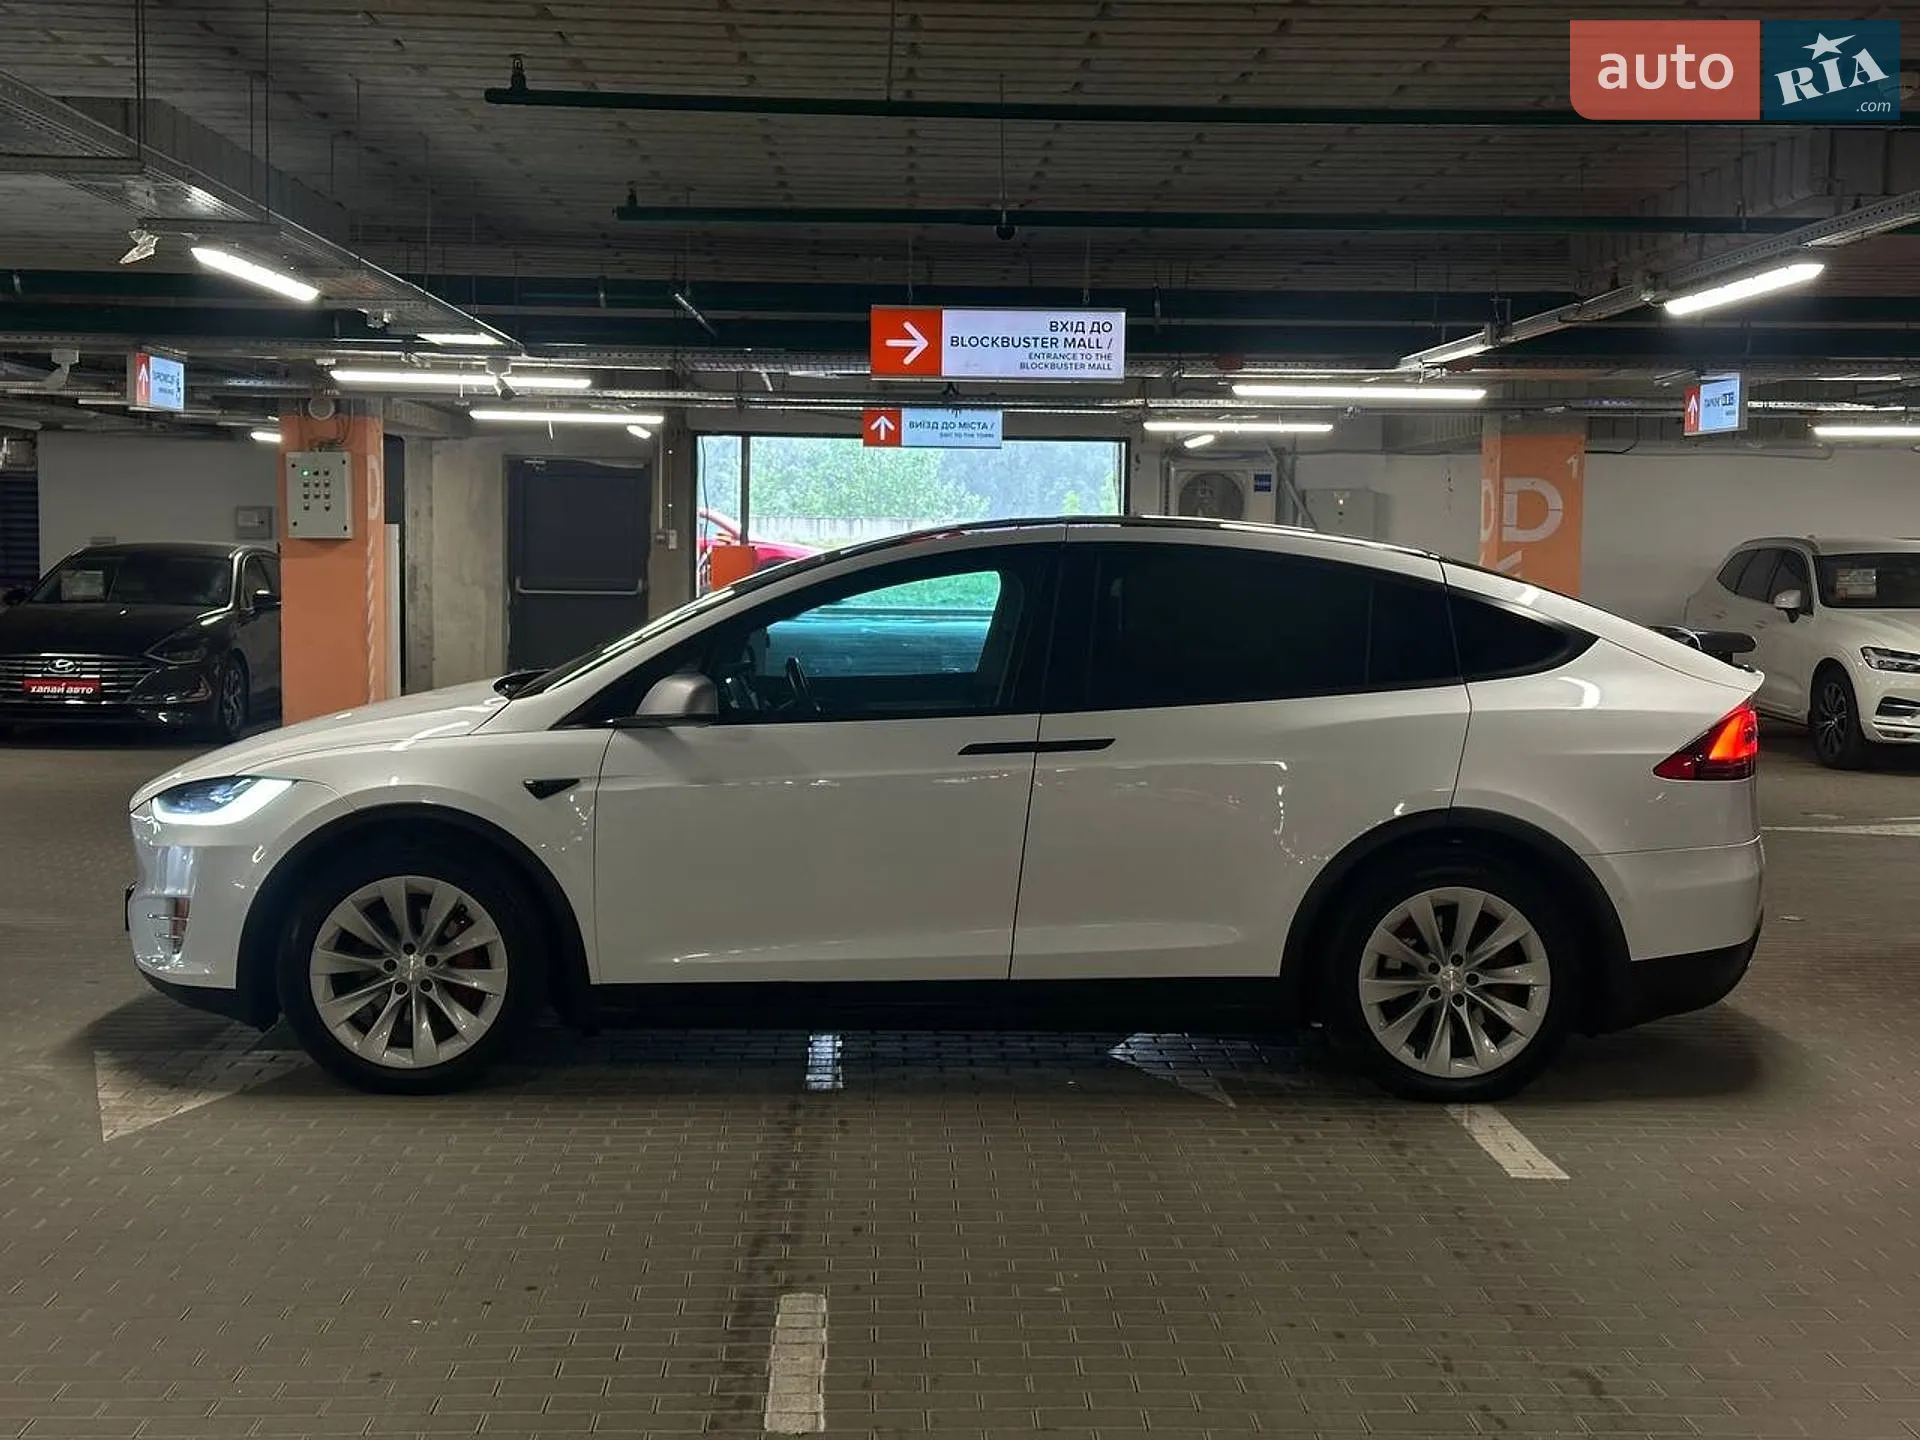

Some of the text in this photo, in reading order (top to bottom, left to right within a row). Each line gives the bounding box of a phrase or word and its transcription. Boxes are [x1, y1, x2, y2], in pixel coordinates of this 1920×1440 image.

[1049, 320, 1113, 334] ВХІД ДО
[950, 335, 1059, 349] BLOCKBUSTER
[1063, 337, 1103, 349] MALL
[1028, 352, 1113, 361] ENTRANCE TO THE
[1019, 362, 1112, 371] BLOCKBUSTER MALL
[940, 421, 957, 431] ДО
[958, 421, 989, 430] МІСТА
[1502, 476, 1564, 542] D
